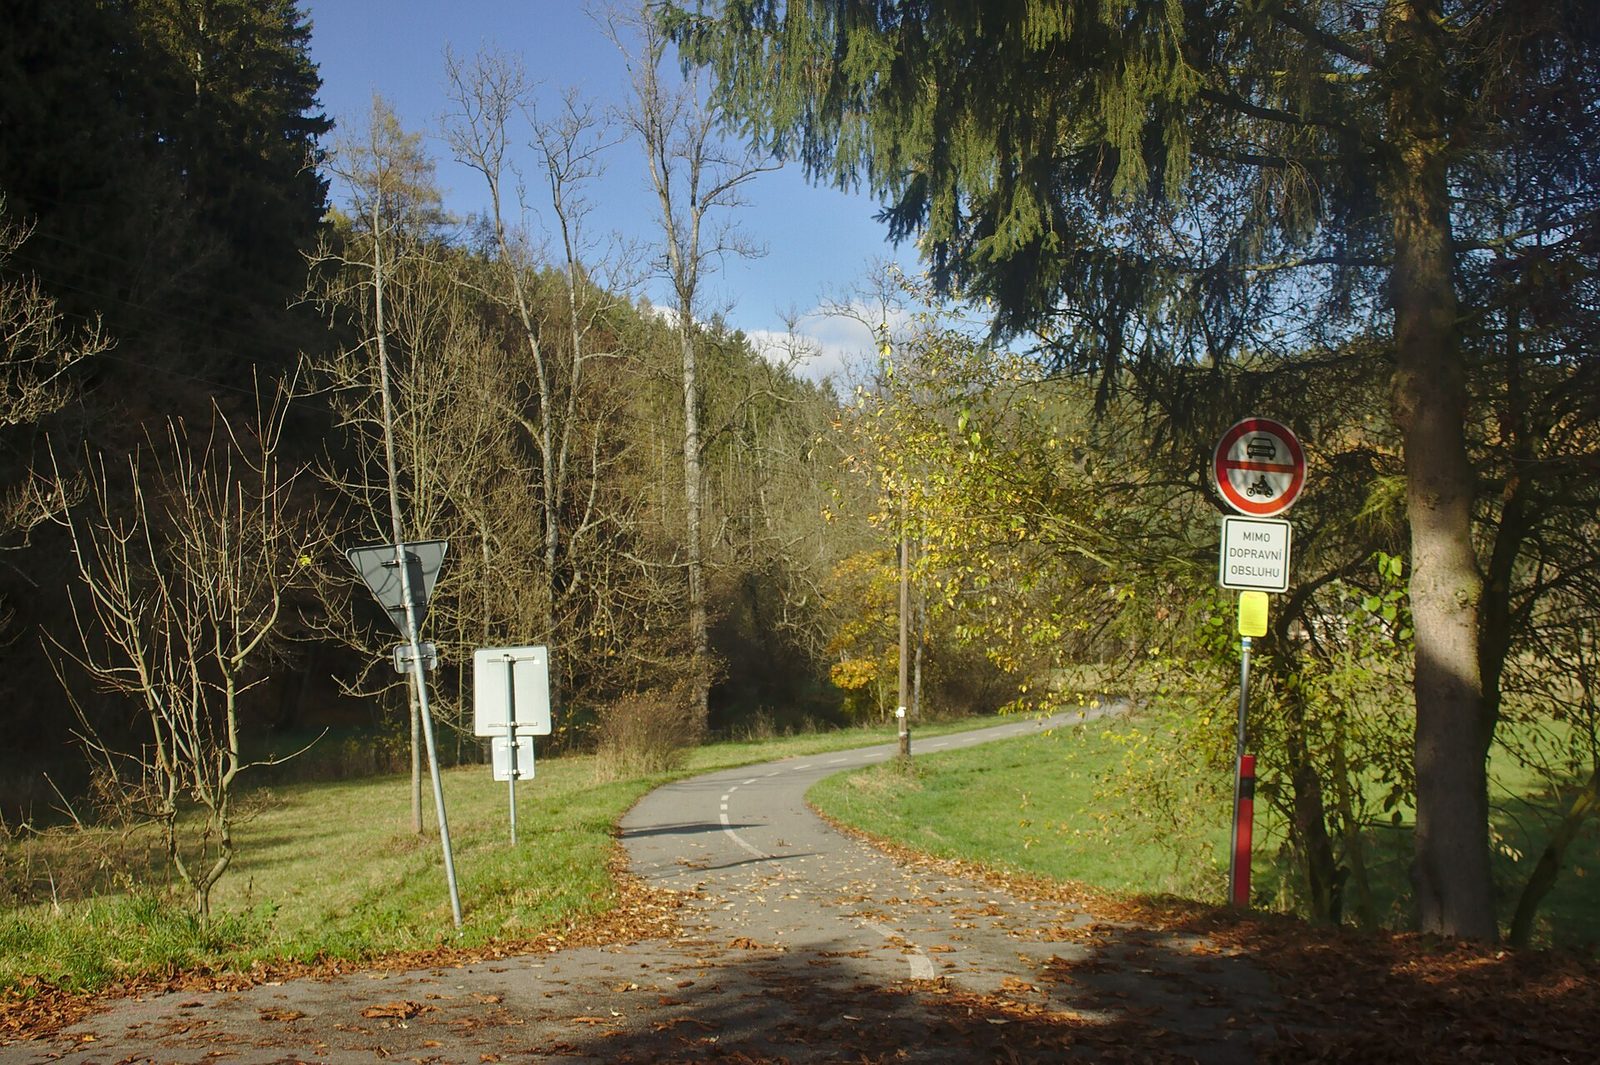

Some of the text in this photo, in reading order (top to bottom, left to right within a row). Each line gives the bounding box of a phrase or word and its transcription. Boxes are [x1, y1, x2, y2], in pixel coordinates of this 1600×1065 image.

[1243, 532, 1271, 543] MIMO
[1229, 547, 1282, 561] DOPRAVNÍ
[1230, 565, 1280, 578] OBSLUHU
